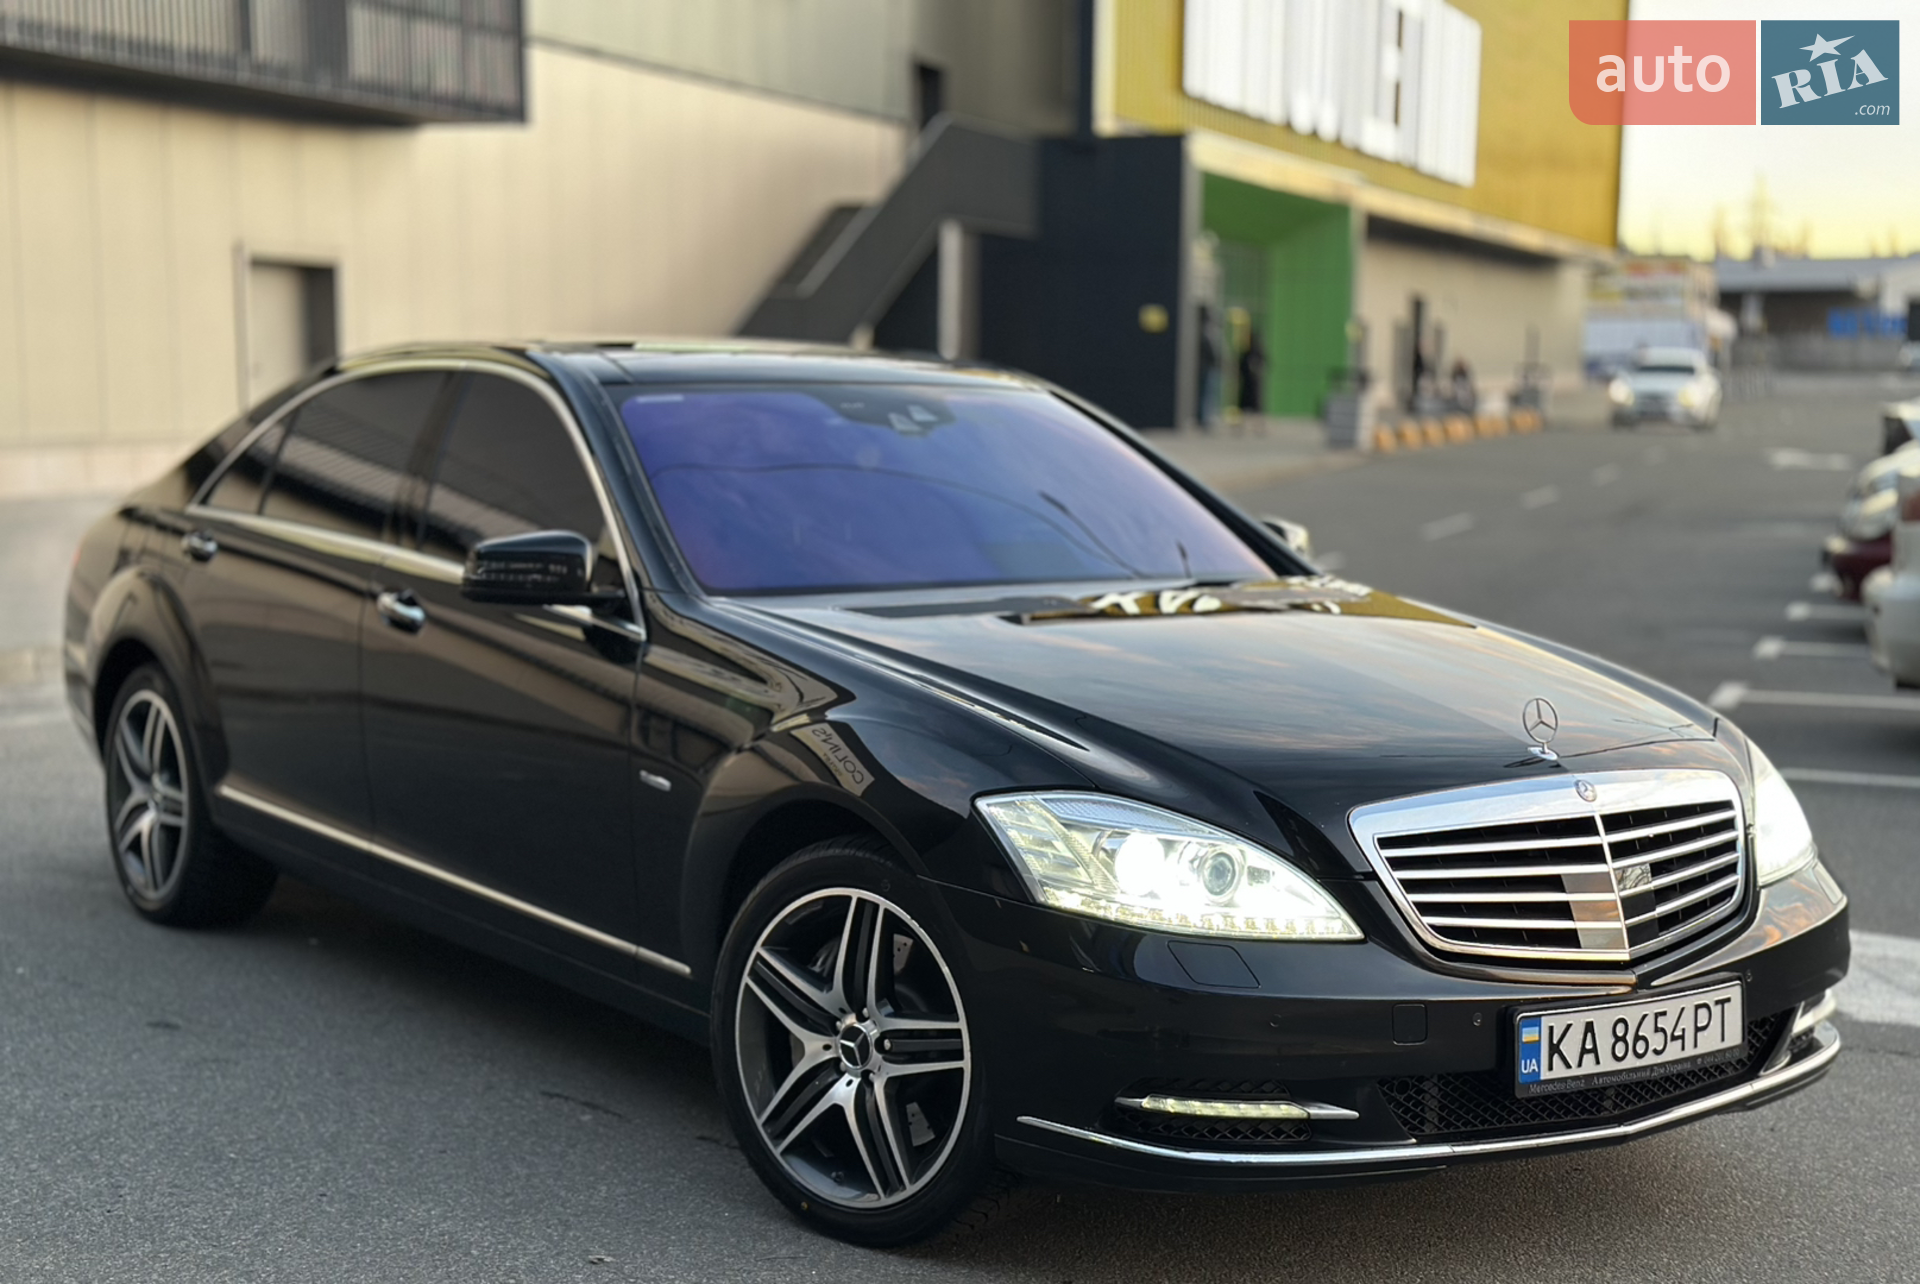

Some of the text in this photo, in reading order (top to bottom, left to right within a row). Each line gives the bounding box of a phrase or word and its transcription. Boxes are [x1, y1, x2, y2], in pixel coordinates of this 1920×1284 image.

[1547, 997, 1731, 1072] KA 8654 PT
[1521, 1061, 1539, 1073] UA
